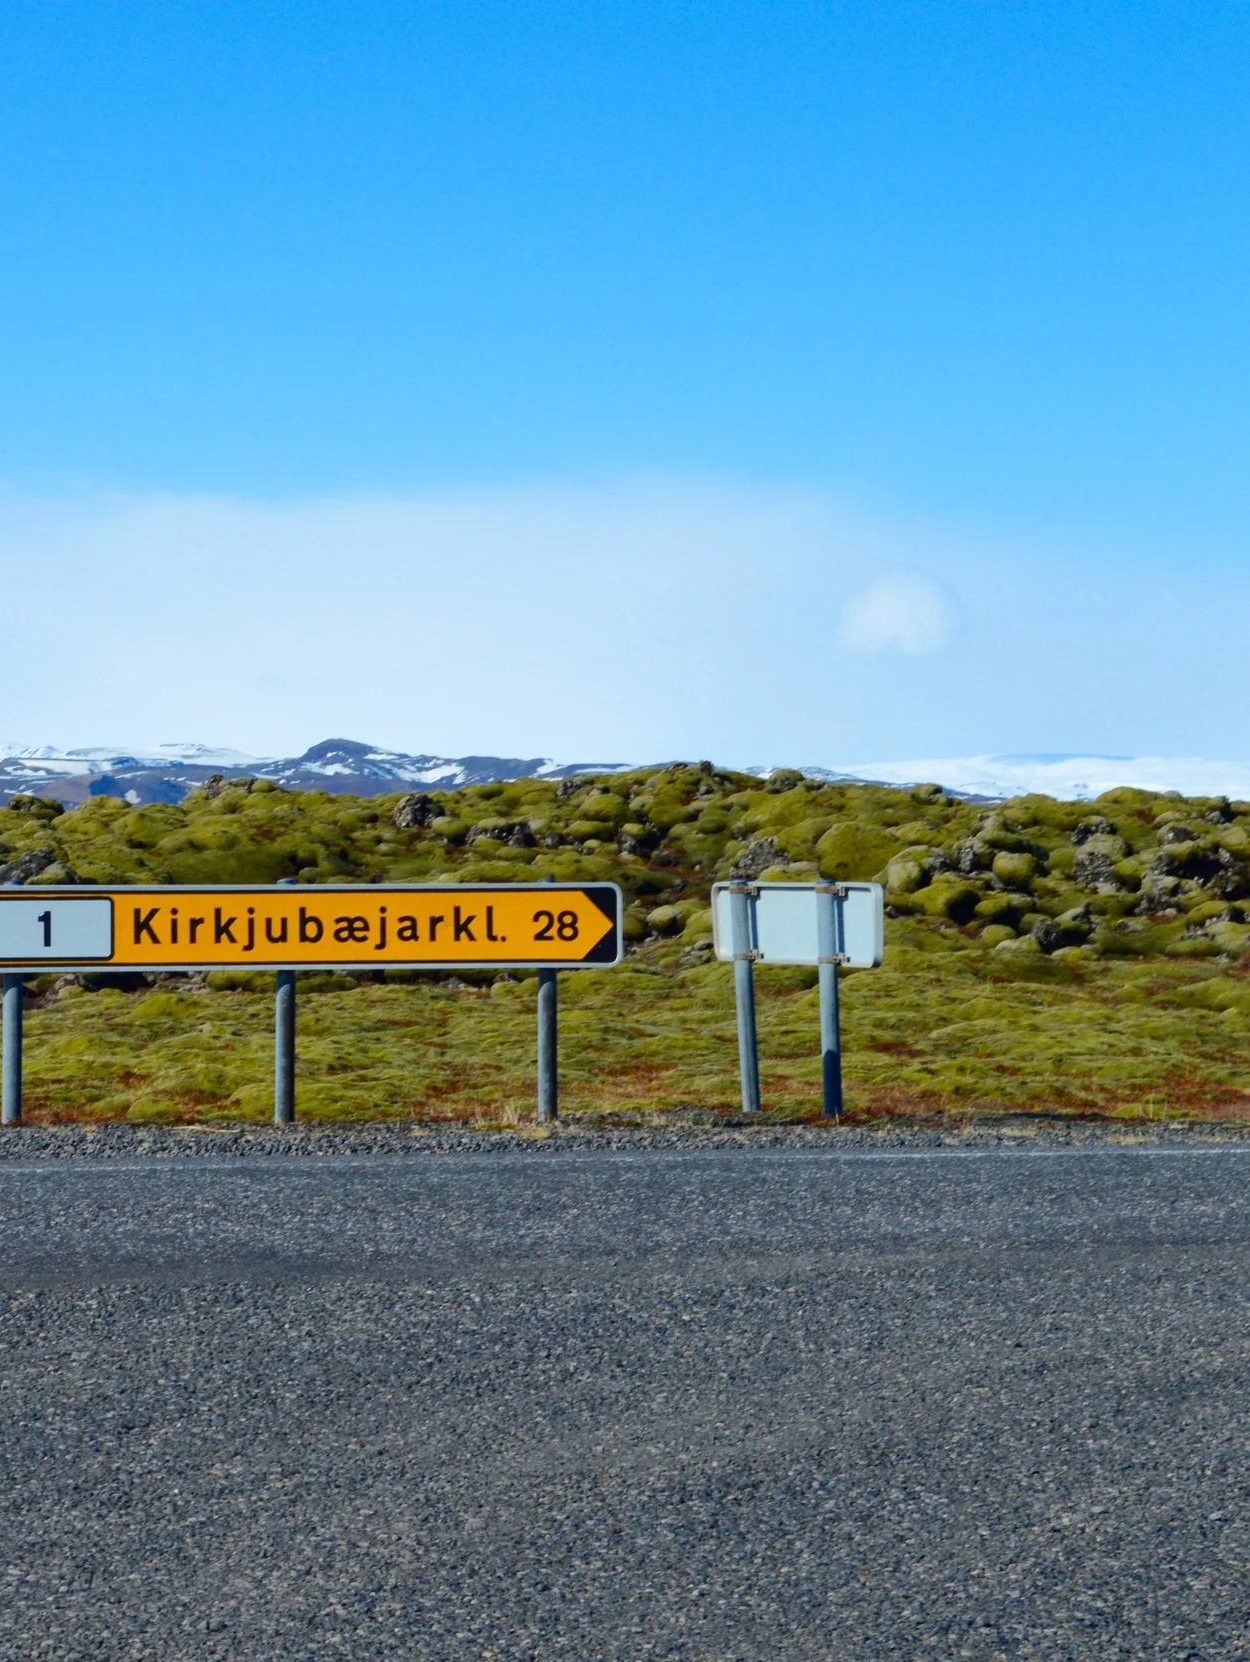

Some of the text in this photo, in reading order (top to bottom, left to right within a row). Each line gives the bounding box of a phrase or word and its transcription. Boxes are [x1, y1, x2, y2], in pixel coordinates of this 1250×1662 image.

[37, 906, 579, 951] 1 Kirkjubæjarkl. 28
